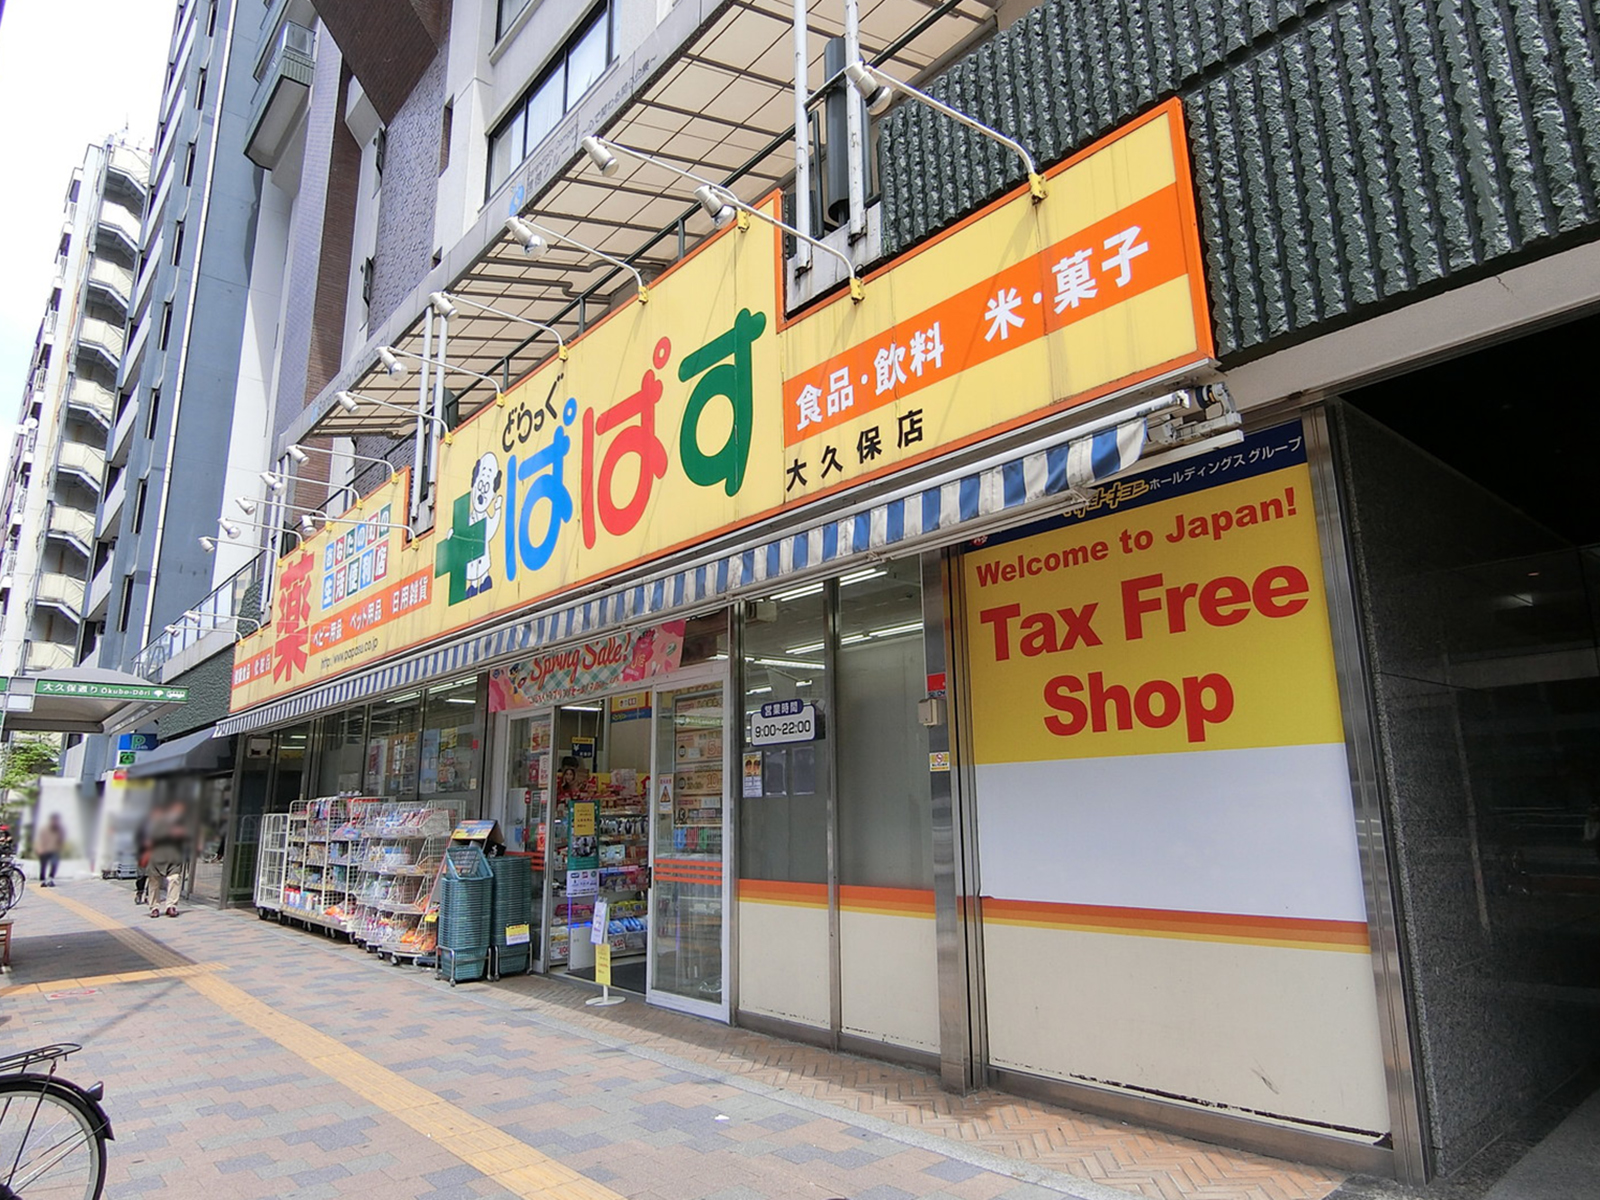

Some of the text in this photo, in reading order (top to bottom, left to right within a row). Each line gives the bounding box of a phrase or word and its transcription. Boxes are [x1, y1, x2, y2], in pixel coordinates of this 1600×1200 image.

[796, 225, 1149, 431] 食品・飲料 米・菓子
[502, 372, 564, 453] どらっぐ
[505, 307, 767, 582] ぱぱす
[786, 408, 925, 492] 大久保店
[1150, 453, 1246, 491] ホールディングス
[1248, 436, 1303, 463] グループ
[976, 487, 1297, 588] Welcome to Japan!
[273, 551, 314, 684] 薬
[980, 565, 1310, 661] Tax Free
[43, 683, 98, 693] 大久保通り
[530, 649, 580, 690] Spring
[583, 632, 632, 670] Sale!
[131, 734, 146, 750] P
[764, 701, 798, 717] 営業時間
[1043, 671, 1235, 743] Shop
